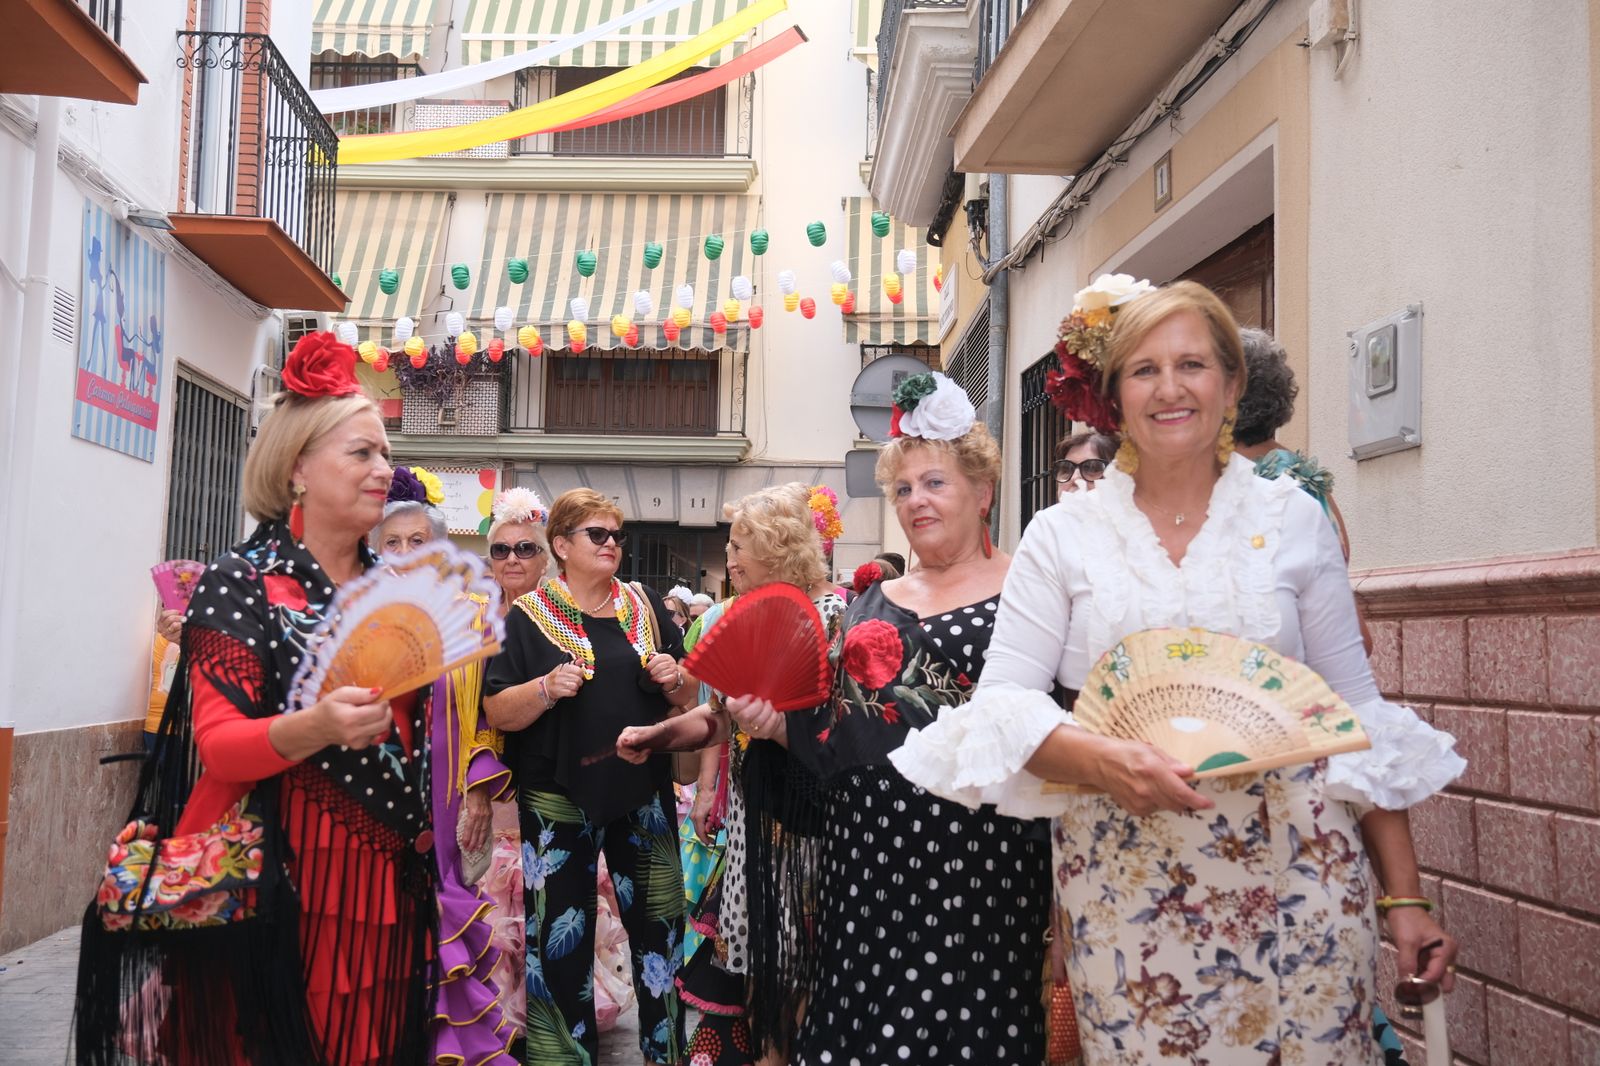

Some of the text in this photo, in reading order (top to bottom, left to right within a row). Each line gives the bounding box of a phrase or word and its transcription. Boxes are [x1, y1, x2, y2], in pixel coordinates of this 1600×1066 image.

[612, 496, 706, 509] 7 9 11
